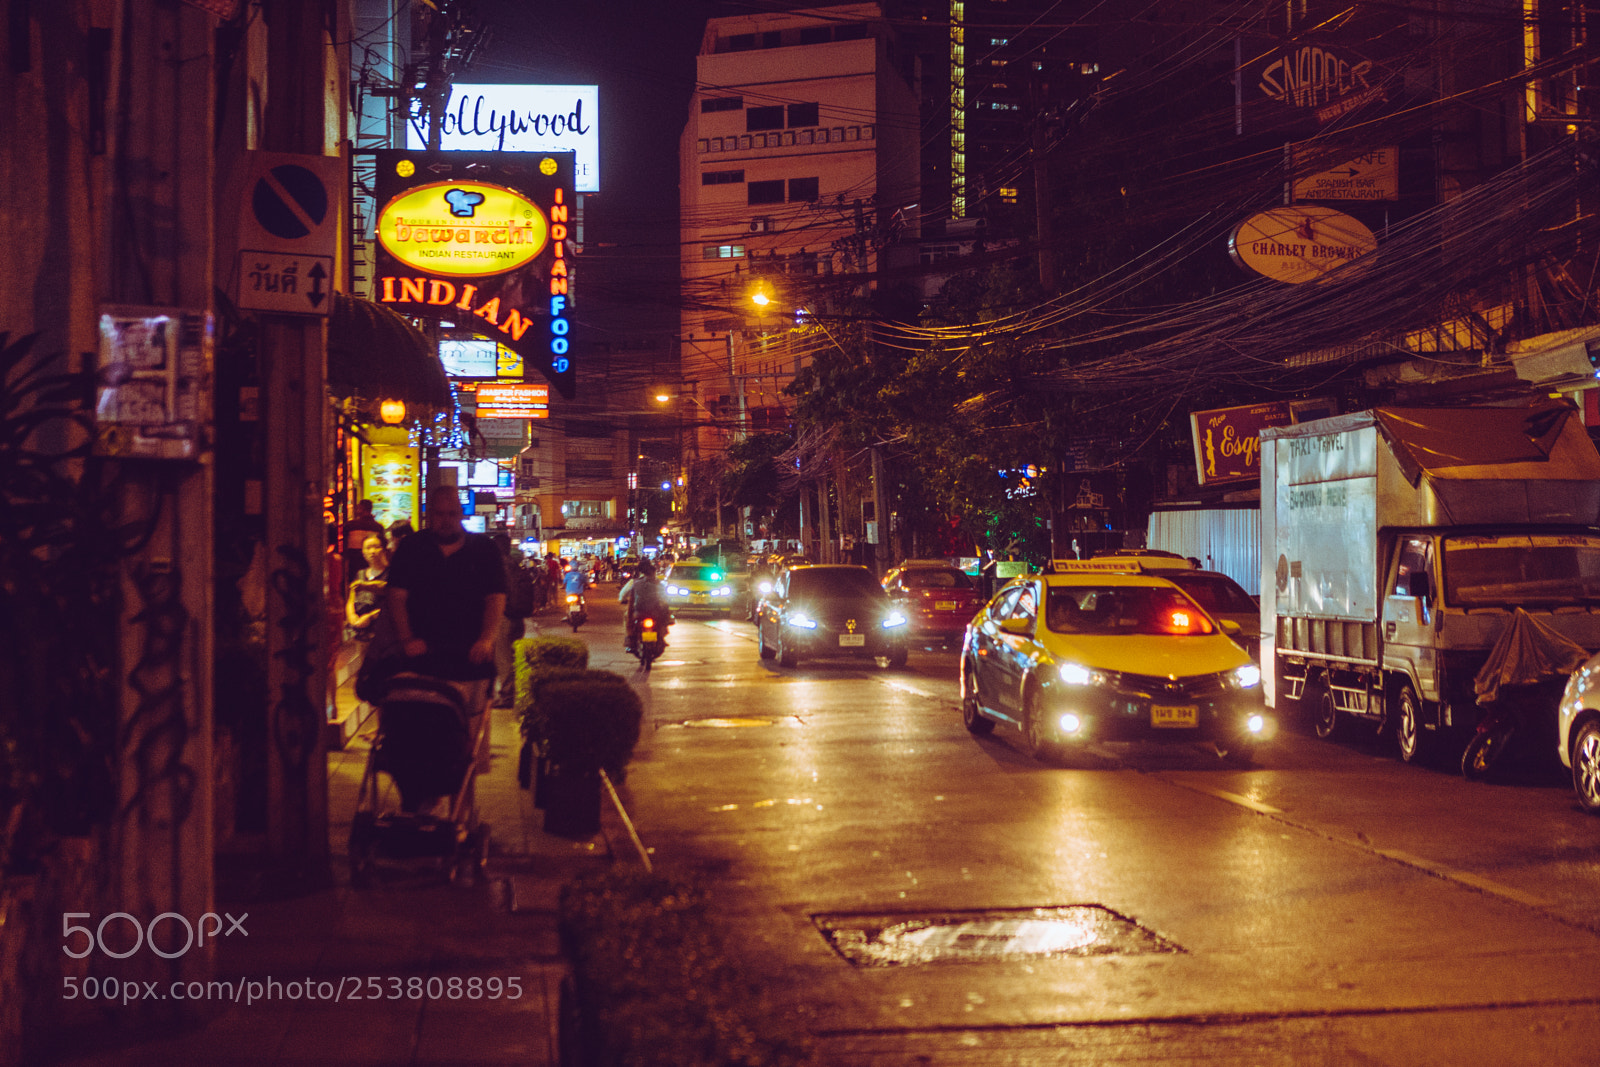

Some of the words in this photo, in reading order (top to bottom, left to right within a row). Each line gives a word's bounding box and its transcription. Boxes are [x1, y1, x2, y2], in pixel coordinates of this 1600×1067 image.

[1259, 46, 1372, 107] SNAPPER
[418, 95, 591, 151] ollywood
[1315, 179, 1353, 188] SPANISH
[1356, 178, 1376, 188] BAR
[419, 250, 451, 258] INDIAN
[454, 251, 516, 260] RESTAURANT
[550, 187, 569, 295] INDIAN
[1252, 242, 1306, 257] CHARLEY
[381, 277, 533, 341] INDIAN
[551, 296, 569, 374] FOOD
[514, 389, 547, 397] FASHION
[1290, 438, 1311, 459] TAXI
[1317, 433, 1344, 453] TRAVEL
